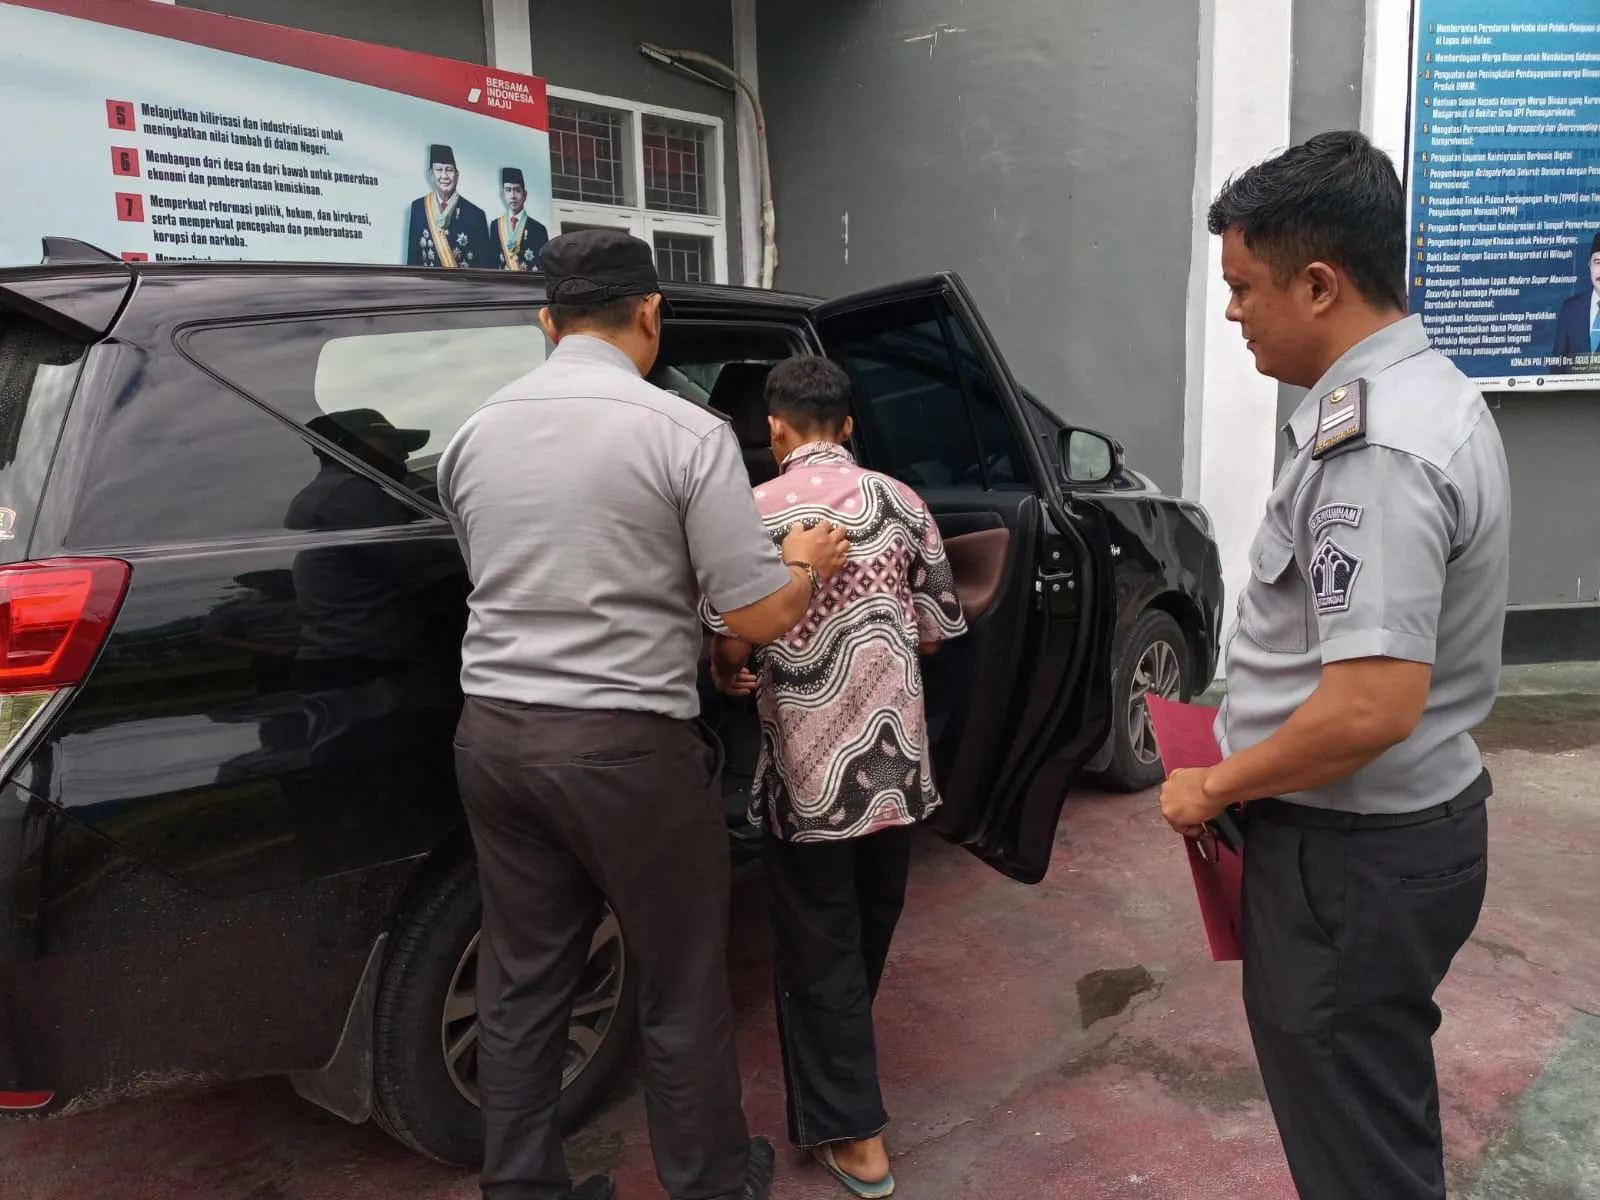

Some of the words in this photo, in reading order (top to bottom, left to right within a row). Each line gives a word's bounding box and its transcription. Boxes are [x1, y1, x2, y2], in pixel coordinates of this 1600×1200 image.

[1436, 24, 1477, 33] Memberantas
[1537, 23, 1548, 32] dan
[1435, 35, 1442, 45] di
[1443, 36, 1459, 45] Lapas
[1461, 35, 1472, 44] dan
[1482, 52, 1501, 63] Warga
[1502, 52, 1522, 61] Binaan
[1523, 52, 1541, 61] untuk
[1434, 70, 1465, 80] Penguatan
[1466, 70, 1477, 78] dan
[1478, 70, 1514, 79] Peningkatan
[1562, 70, 1580, 79] warga
[486, 77, 529, 94] BERSAMA
[1434, 82, 1455, 91] Produk
[487, 87, 534, 104] INDONESIA
[1433, 98, 1457, 106] Bantuan
[1458, 97, 1476, 106] Sosial
[1478, 97, 1498, 106] Kepada
[1500, 97, 1526, 106] Keluarga
[1527, 96, 1546, 106] Warga
[1548, 96, 1567, 105] Binaan
[1569, 97, 1582, 106] yang
[488, 97, 512, 109] MAJU
[116, 106, 126, 124] 5
[1433, 109, 1467, 119] Masyarakat
[1469, 109, 1474, 117] di
[1514, 108, 1524, 117] UPT
[141, 103, 198, 122] Melanjutkan
[200, 111, 241, 128] hilirisasi
[243, 117, 258, 130] dan
[260, 119, 320, 138] industrialisasi
[322, 129, 344, 141] untuk
[1432, 125, 1462, 134] Mengatasi
[1463, 124, 1504, 133] Permasalahan
[144, 123, 207, 140] meningkatkan
[210, 130, 229, 143] nilai
[231, 132, 262, 147] tambah
[264, 137, 272, 148] di
[274, 138, 298, 152] dalam
[300, 141, 329, 155] Negeri.
[120, 152, 130, 171] 6
[1431, 154, 1461, 163] Penguatan
[1462, 153, 1486, 162] Layanan
[1488, 152, 1525, 162] Keimigrasian
[1527, 152, 1552, 160] Berbasis
[1554, 151, 1572, 161] Digital
[146, 149, 201, 168] Membangun
[203, 156, 221, 169] dari
[224, 158, 243, 171] desa
[246, 160, 261, 173] dan
[263, 162, 280, 175] dari
[282, 164, 308, 178] bawah
[310, 169, 332, 181] untuk
[334, 172, 378, 186] pemerataan
[1430, 169, 1473, 178] Pengembangan
[1502, 168, 1515, 176] Pada
[1541, 167, 1565, 176] Bandara
[1566, 167, 1587, 176] dengan
[148, 168, 186, 183] ekonomi
[189, 172, 204, 184] dan
[207, 175, 272, 190] pemberantasan
[274, 180, 323, 196] kemiskinan.
[1429, 196, 1463, 206] Pencegahan
[1464, 196, 1483, 204] Tindak
[1485, 196, 1504, 204] Pidana
[1505, 195, 1542, 204] Perdagangan
[1560, 192, 1578, 204] (TPPO)
[125, 198, 133, 216] 7
[150, 195, 207, 211] Memperkuat
[209, 201, 252, 214] reformasi
[255, 204, 284, 218] politik,
[286, 206, 315, 221] hukum,
[317, 209, 331, 222] dan
[333, 210, 371, 226] birokrasi,
[1429, 208, 1472, 217] Penyelundupan
[152, 214, 176, 226] serta
[179, 216, 234, 230] memperkuat
[236, 221, 285, 234] pencegahan
[288, 223, 302, 234] dan
[304, 225, 363, 239] pemberantasan
[1428, 224, 1458, 233] Penguatan
[1459, 223, 1496, 232] Pemeriksaan
[1498, 222, 1535, 232] Keimigrasian
[1537, 221, 1542, 230] di
[1544, 221, 1564, 231] Tempat
[153, 229, 189, 245] korupsi
[191, 232, 207, 244] dan
[210, 234, 248, 247] narkoba.
[1428, 238, 1470, 248] Pengembangan
[1472, 238, 1492, 246] Lounge
[1493, 237, 1514, 245] Khusus
[1515, 236, 1532, 245] untuk
[1533, 236, 1554, 245] Pekerja
[1426, 253, 1441, 261] Bakti
[1443, 252, 1460, 261] Sosial
[1462, 252, 1482, 262] dengan
[1484, 251, 1507, 260] Sasaran
[1508, 250, 1541, 260] Masyarakat
[1543, 250, 1549, 258] di
[1550, 250, 1572, 259] Wilayah
[1426, 278, 1460, 287] Membangun
[1462, 277, 1489, 286] Tambahan
[1491, 277, 1507, 286] Lapas
[1508, 276, 1530, 284] Modern
[1531, 276, 1548, 285] Super
[1550, 275, 1577, 284] Maximum
[1426, 289, 1450, 299] Security
[1451, 289, 1461, 297] dan
[1462, 289, 1487, 298] Lembaga
[1489, 288, 1520, 296] Pendidikan
[1424, 300, 1457, 309] Berstandar
[1464, 313, 1498, 323] Kebanggaan
[1500, 313, 1524, 321] Lembaga
[1526, 312, 1557, 320] Pendidikan
[1445, 325, 1489, 334] Mengembalikan
[1490, 324, 1506, 332] Nama
[1459, 336, 1480, 345] Menjadi
[1507, 334, 1531, 344] Imigrasi
[1532, 357, 1542, 366] POL
[1575, 356, 1589, 364] AGUS
